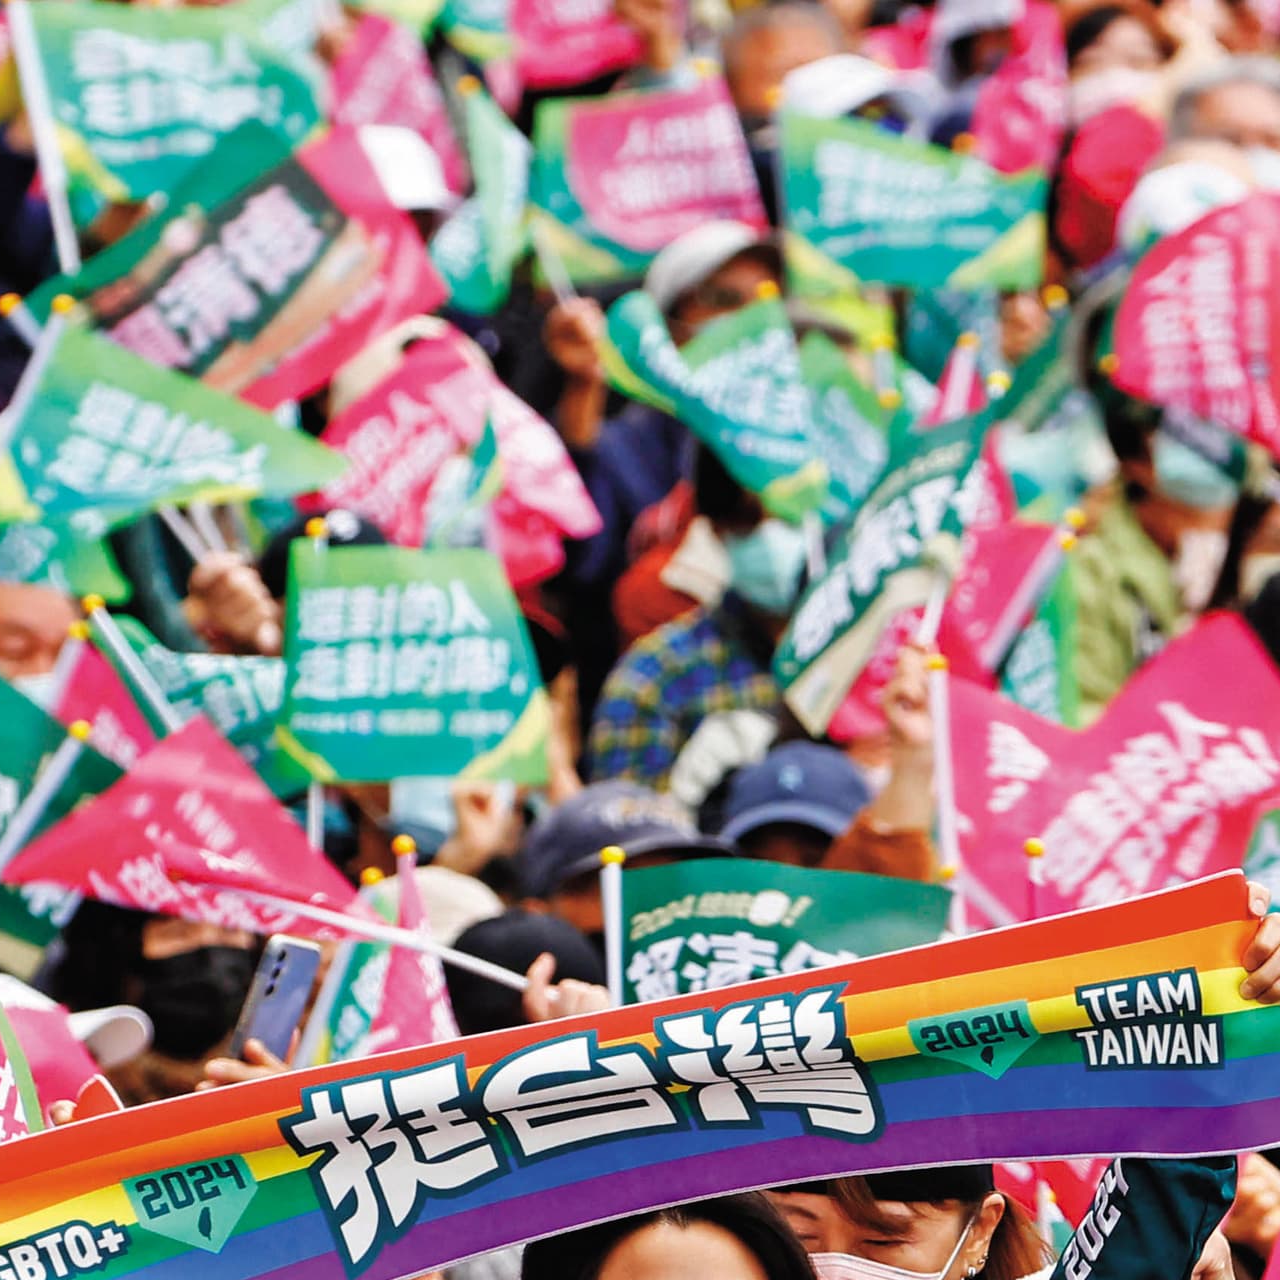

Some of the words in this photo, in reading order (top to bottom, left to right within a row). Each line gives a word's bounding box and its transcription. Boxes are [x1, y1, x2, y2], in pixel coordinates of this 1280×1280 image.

[1081, 972, 1196, 1024] TEAM
[920, 1009, 1029, 1054] 2024
[1078, 1022, 1220, 1067] TAIWAN
[286, 986, 876, 1267] 挺台灣
[136, 1158, 247, 1221] 2024
